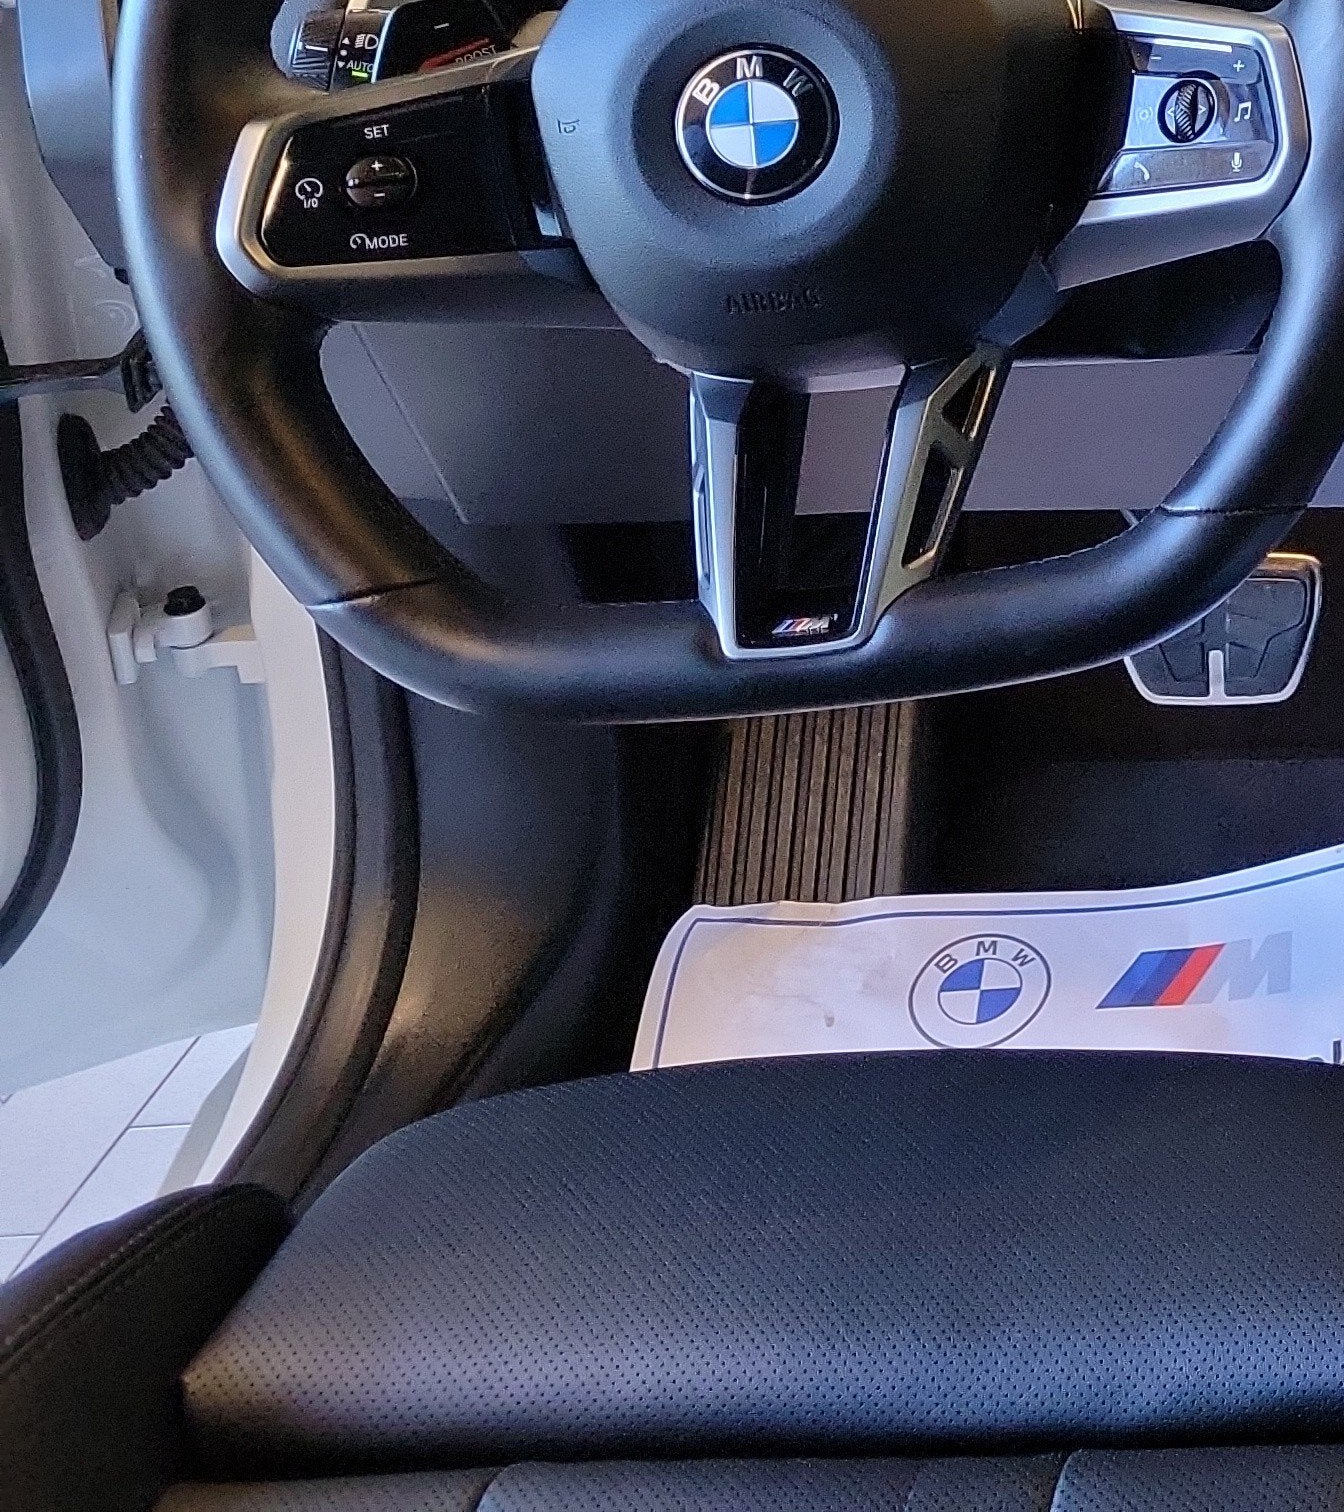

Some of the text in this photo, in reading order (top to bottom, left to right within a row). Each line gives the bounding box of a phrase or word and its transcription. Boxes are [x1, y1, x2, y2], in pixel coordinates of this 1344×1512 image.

[346, 60, 373, 74] AUTO
[692, 55, 814, 106] BMW
[363, 124, 390, 139] SET
[365, 233, 409, 250] MODE
[934, 940, 1036, 974] BMW
